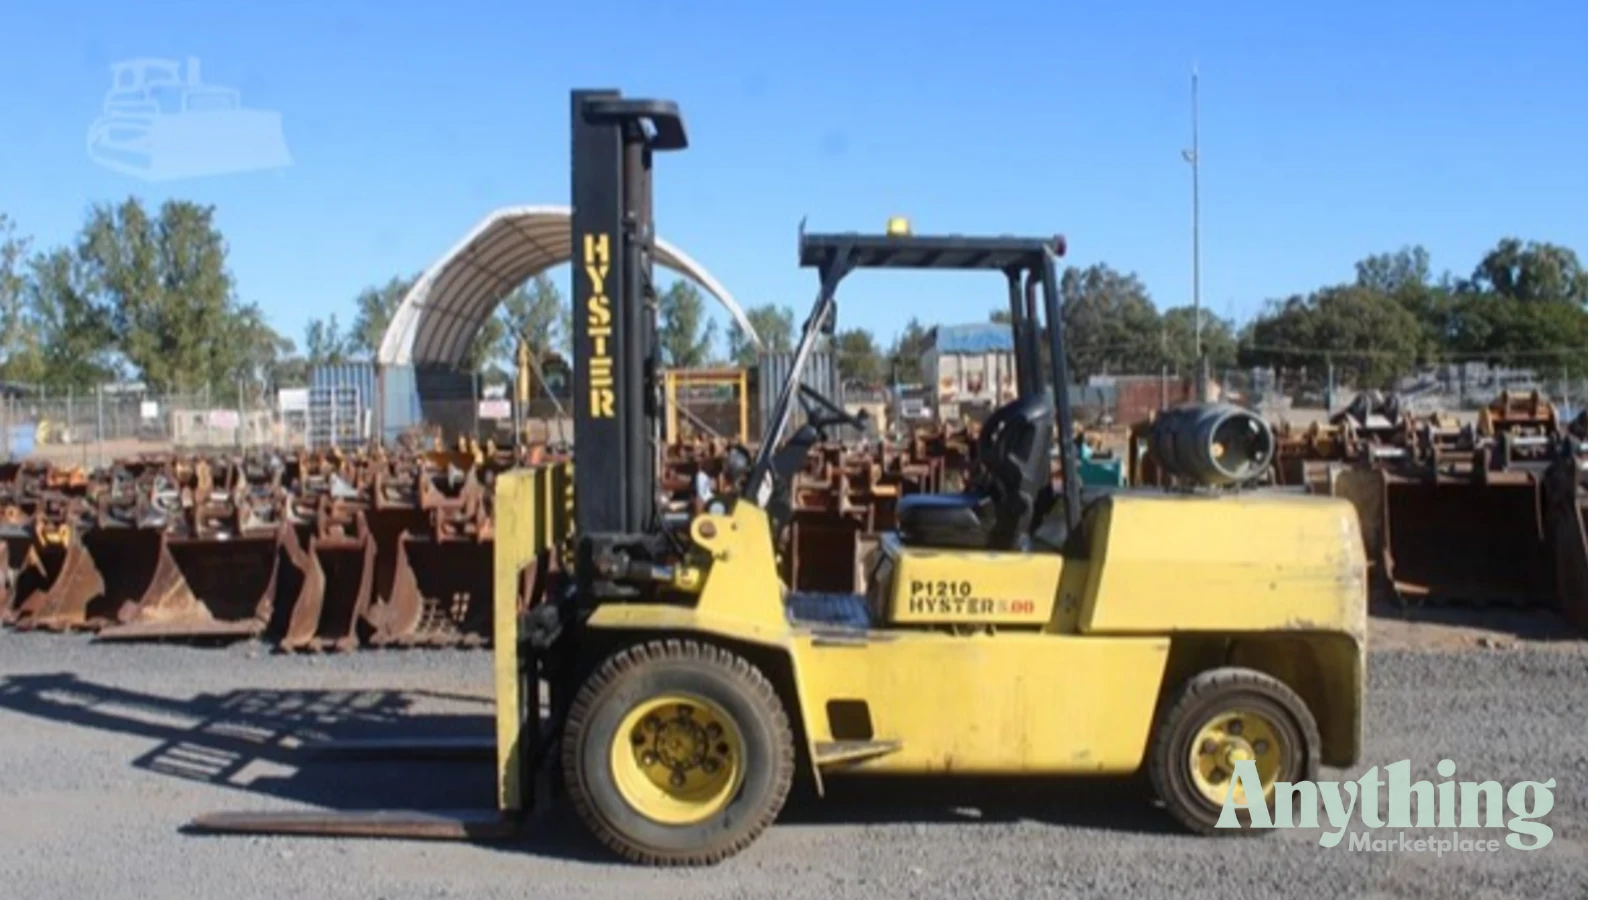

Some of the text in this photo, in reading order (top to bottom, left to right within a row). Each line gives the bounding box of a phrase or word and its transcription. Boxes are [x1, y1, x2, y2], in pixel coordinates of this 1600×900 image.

[583, 233, 615, 418] HYSTER
[911, 580, 972, 596] P1210
[909, 598, 994, 614] HYSTER
